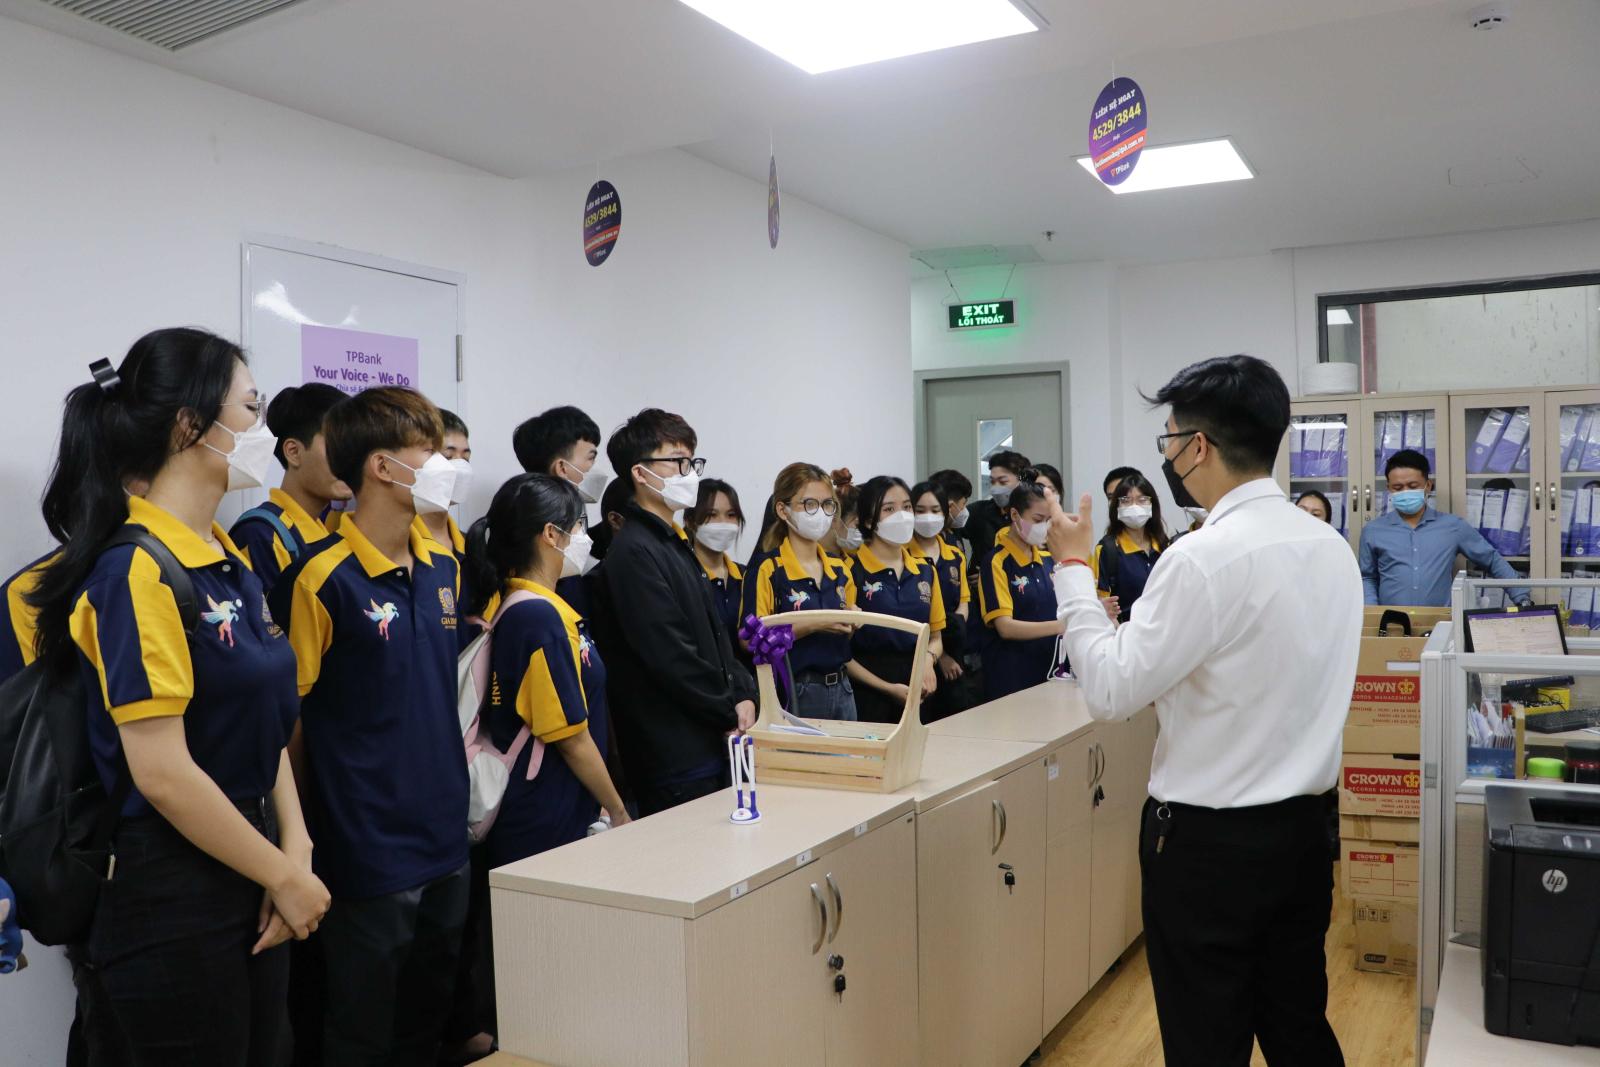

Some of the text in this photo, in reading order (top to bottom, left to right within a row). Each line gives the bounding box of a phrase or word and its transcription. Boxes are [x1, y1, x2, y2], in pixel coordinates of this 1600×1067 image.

[1118, 89, 1136, 105] NGAY
[1092, 102, 1142, 141] 4529/3844
[962, 303, 1000, 316] EXIT
[975, 314, 1005, 325] THOÁT
[346, 351, 382, 365] TPBank
[314, 365, 338, 380] Your
[340, 367, 369, 382] Voice
[378, 372, 394, 385] We
[396, 373, 410, 386] Do
[1355, 681, 1396, 693] ROWN
[1349, 773, 1402, 786] CROWN
[1544, 868, 1566, 893] hp
